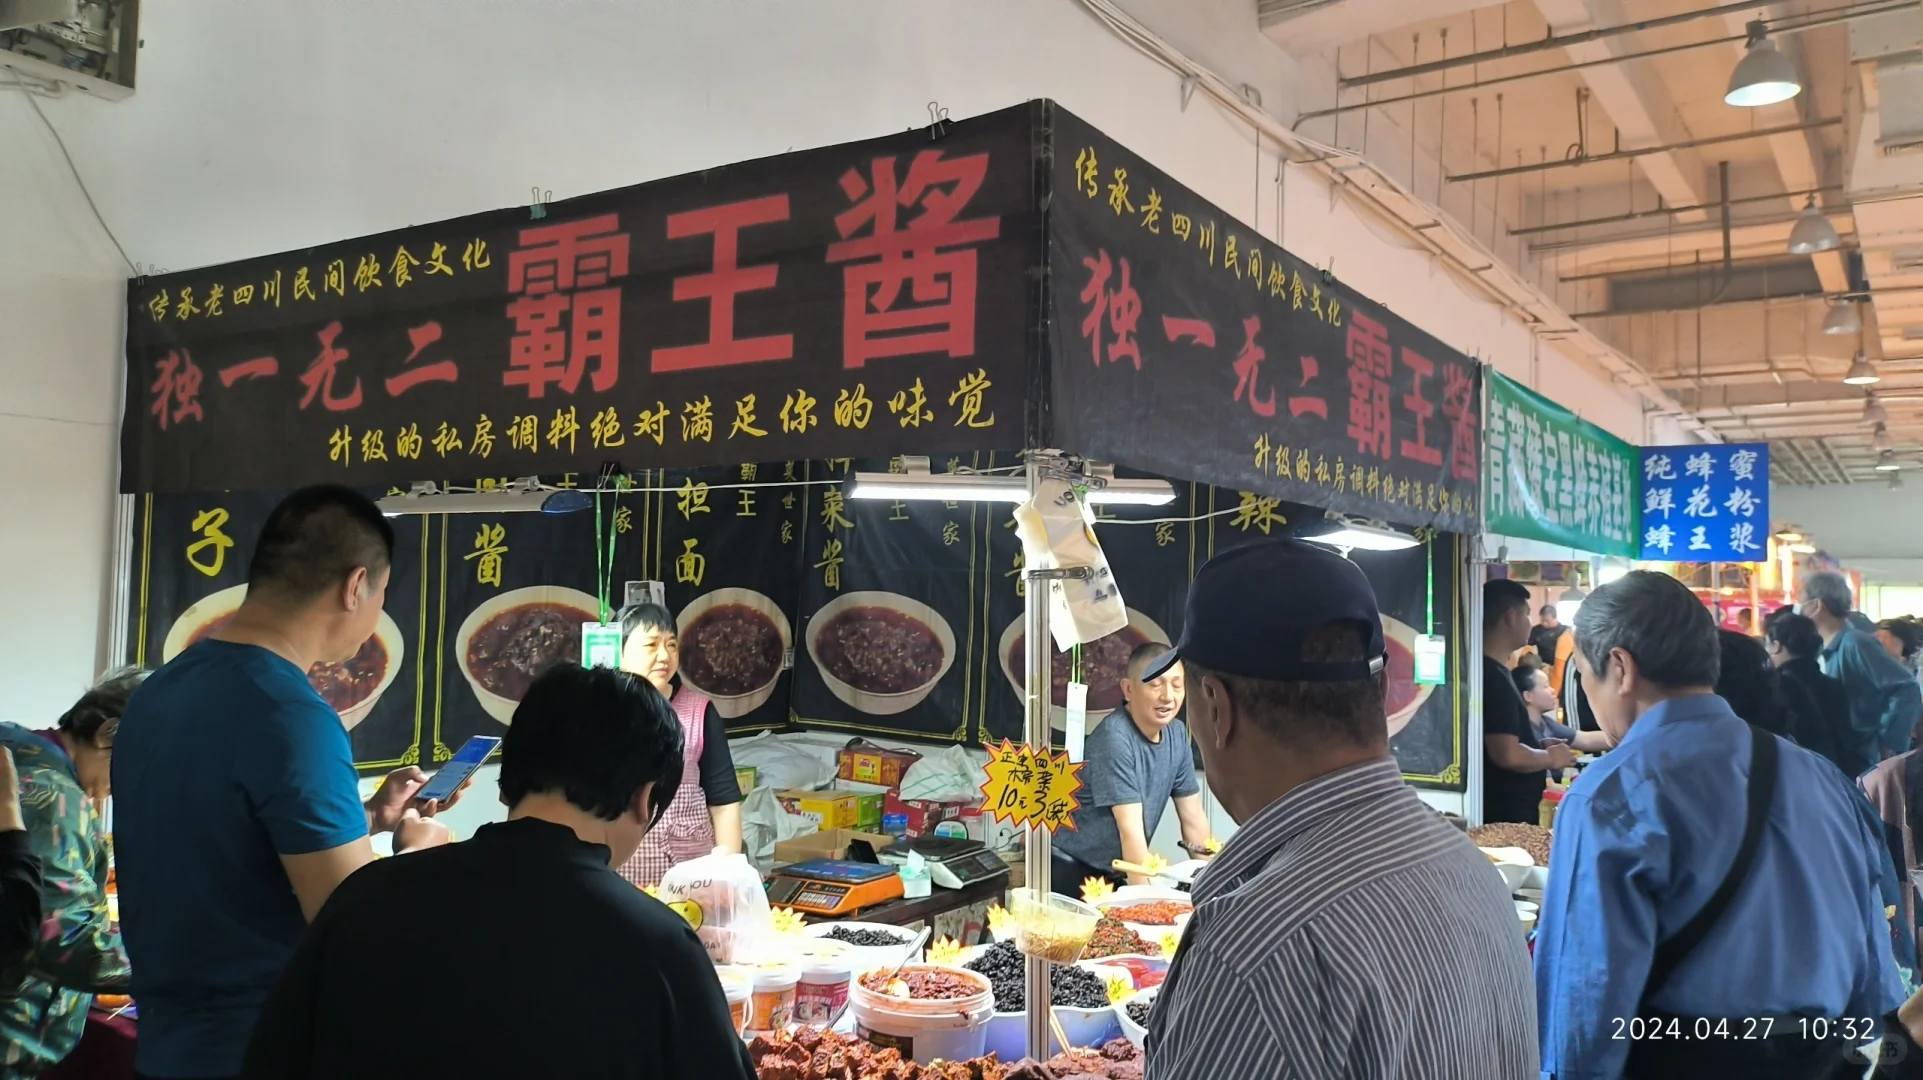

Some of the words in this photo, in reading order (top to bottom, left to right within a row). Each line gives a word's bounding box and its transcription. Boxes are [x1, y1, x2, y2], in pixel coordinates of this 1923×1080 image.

[148, 237, 491, 323] 传承老四川民间饮食文化
[1075, 147, 1342, 327] 传承老四川民间饮食文化
[151, 321, 458, 431] 独一无二
[503, 149, 1000, 399] 霸王酱
[1080, 248, 1328, 420] 独一无二
[1345, 309, 1478, 485] 霸王酱
[328, 368, 995, 468] 升级的私房调料绝对满足你的味觉
[1643, 449, 1759, 482] 纯蜂蜜
[1643, 484, 1761, 520] 鲜花粉
[1643, 525, 1762, 555] 蜂王浆
